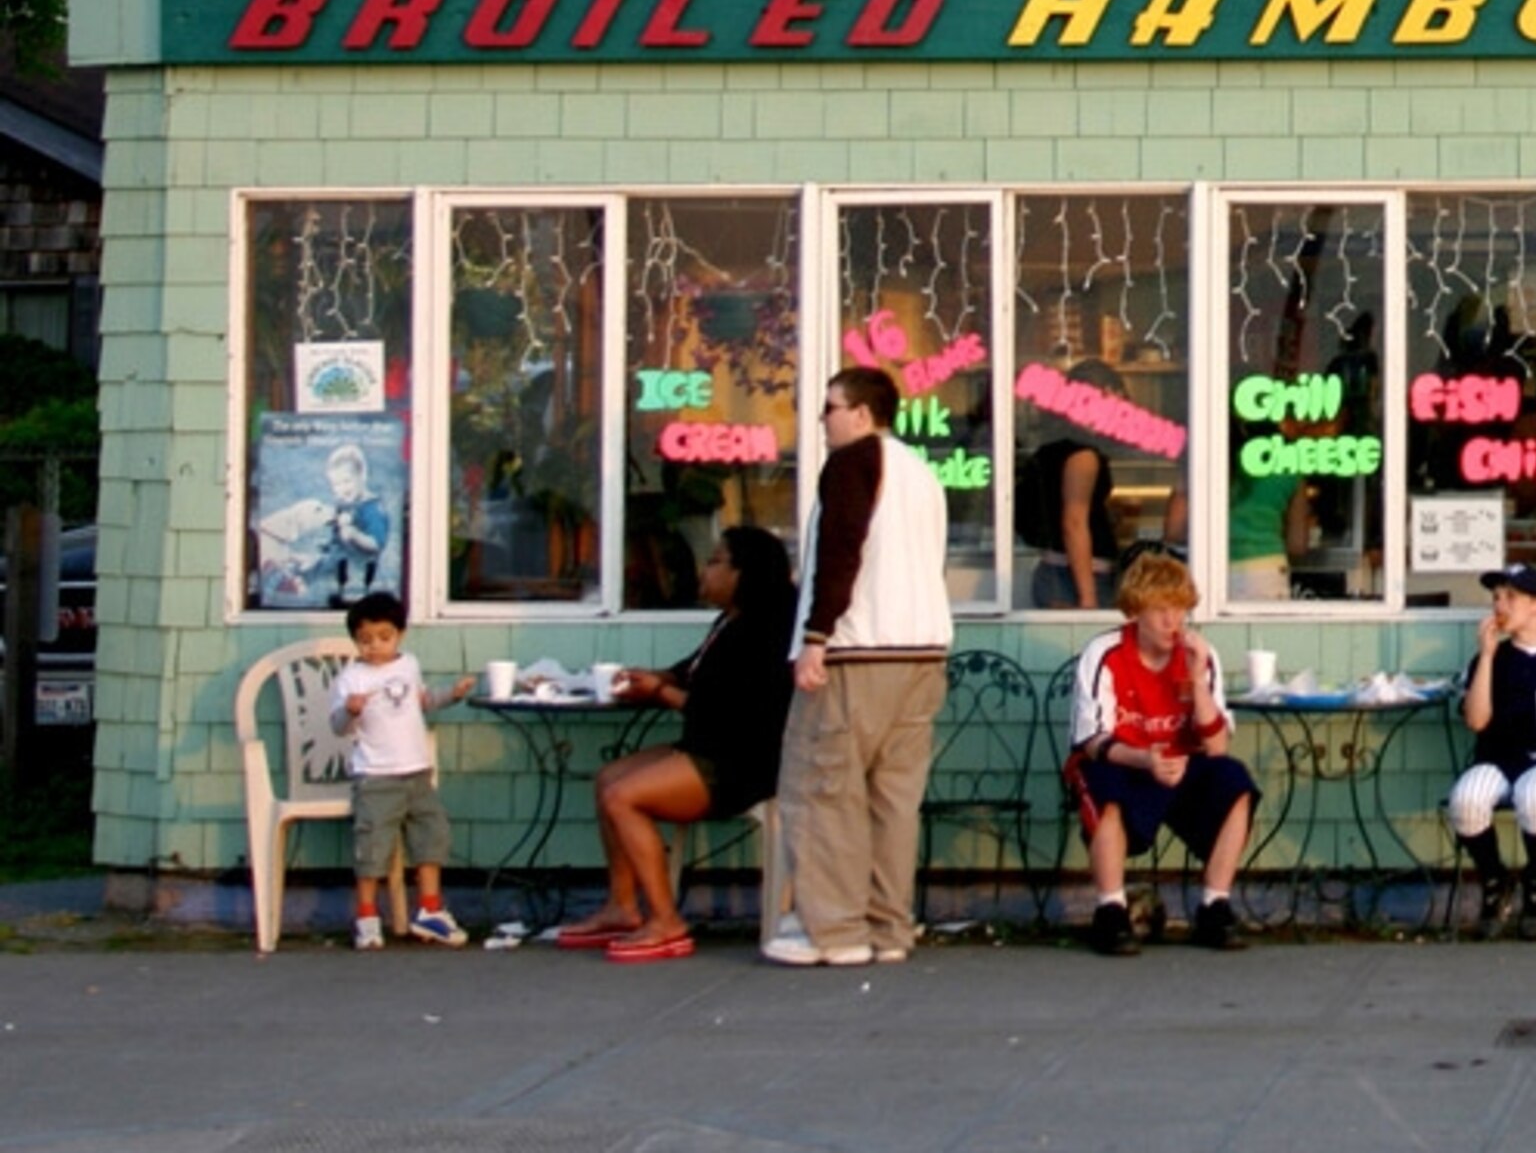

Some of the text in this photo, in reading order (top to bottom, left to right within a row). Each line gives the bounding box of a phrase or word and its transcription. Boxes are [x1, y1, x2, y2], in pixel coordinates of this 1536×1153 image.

[635, 369, 713, 412] ICE
[896, 395, 952, 437] ilk
[660, 421, 779, 463] CREAM
